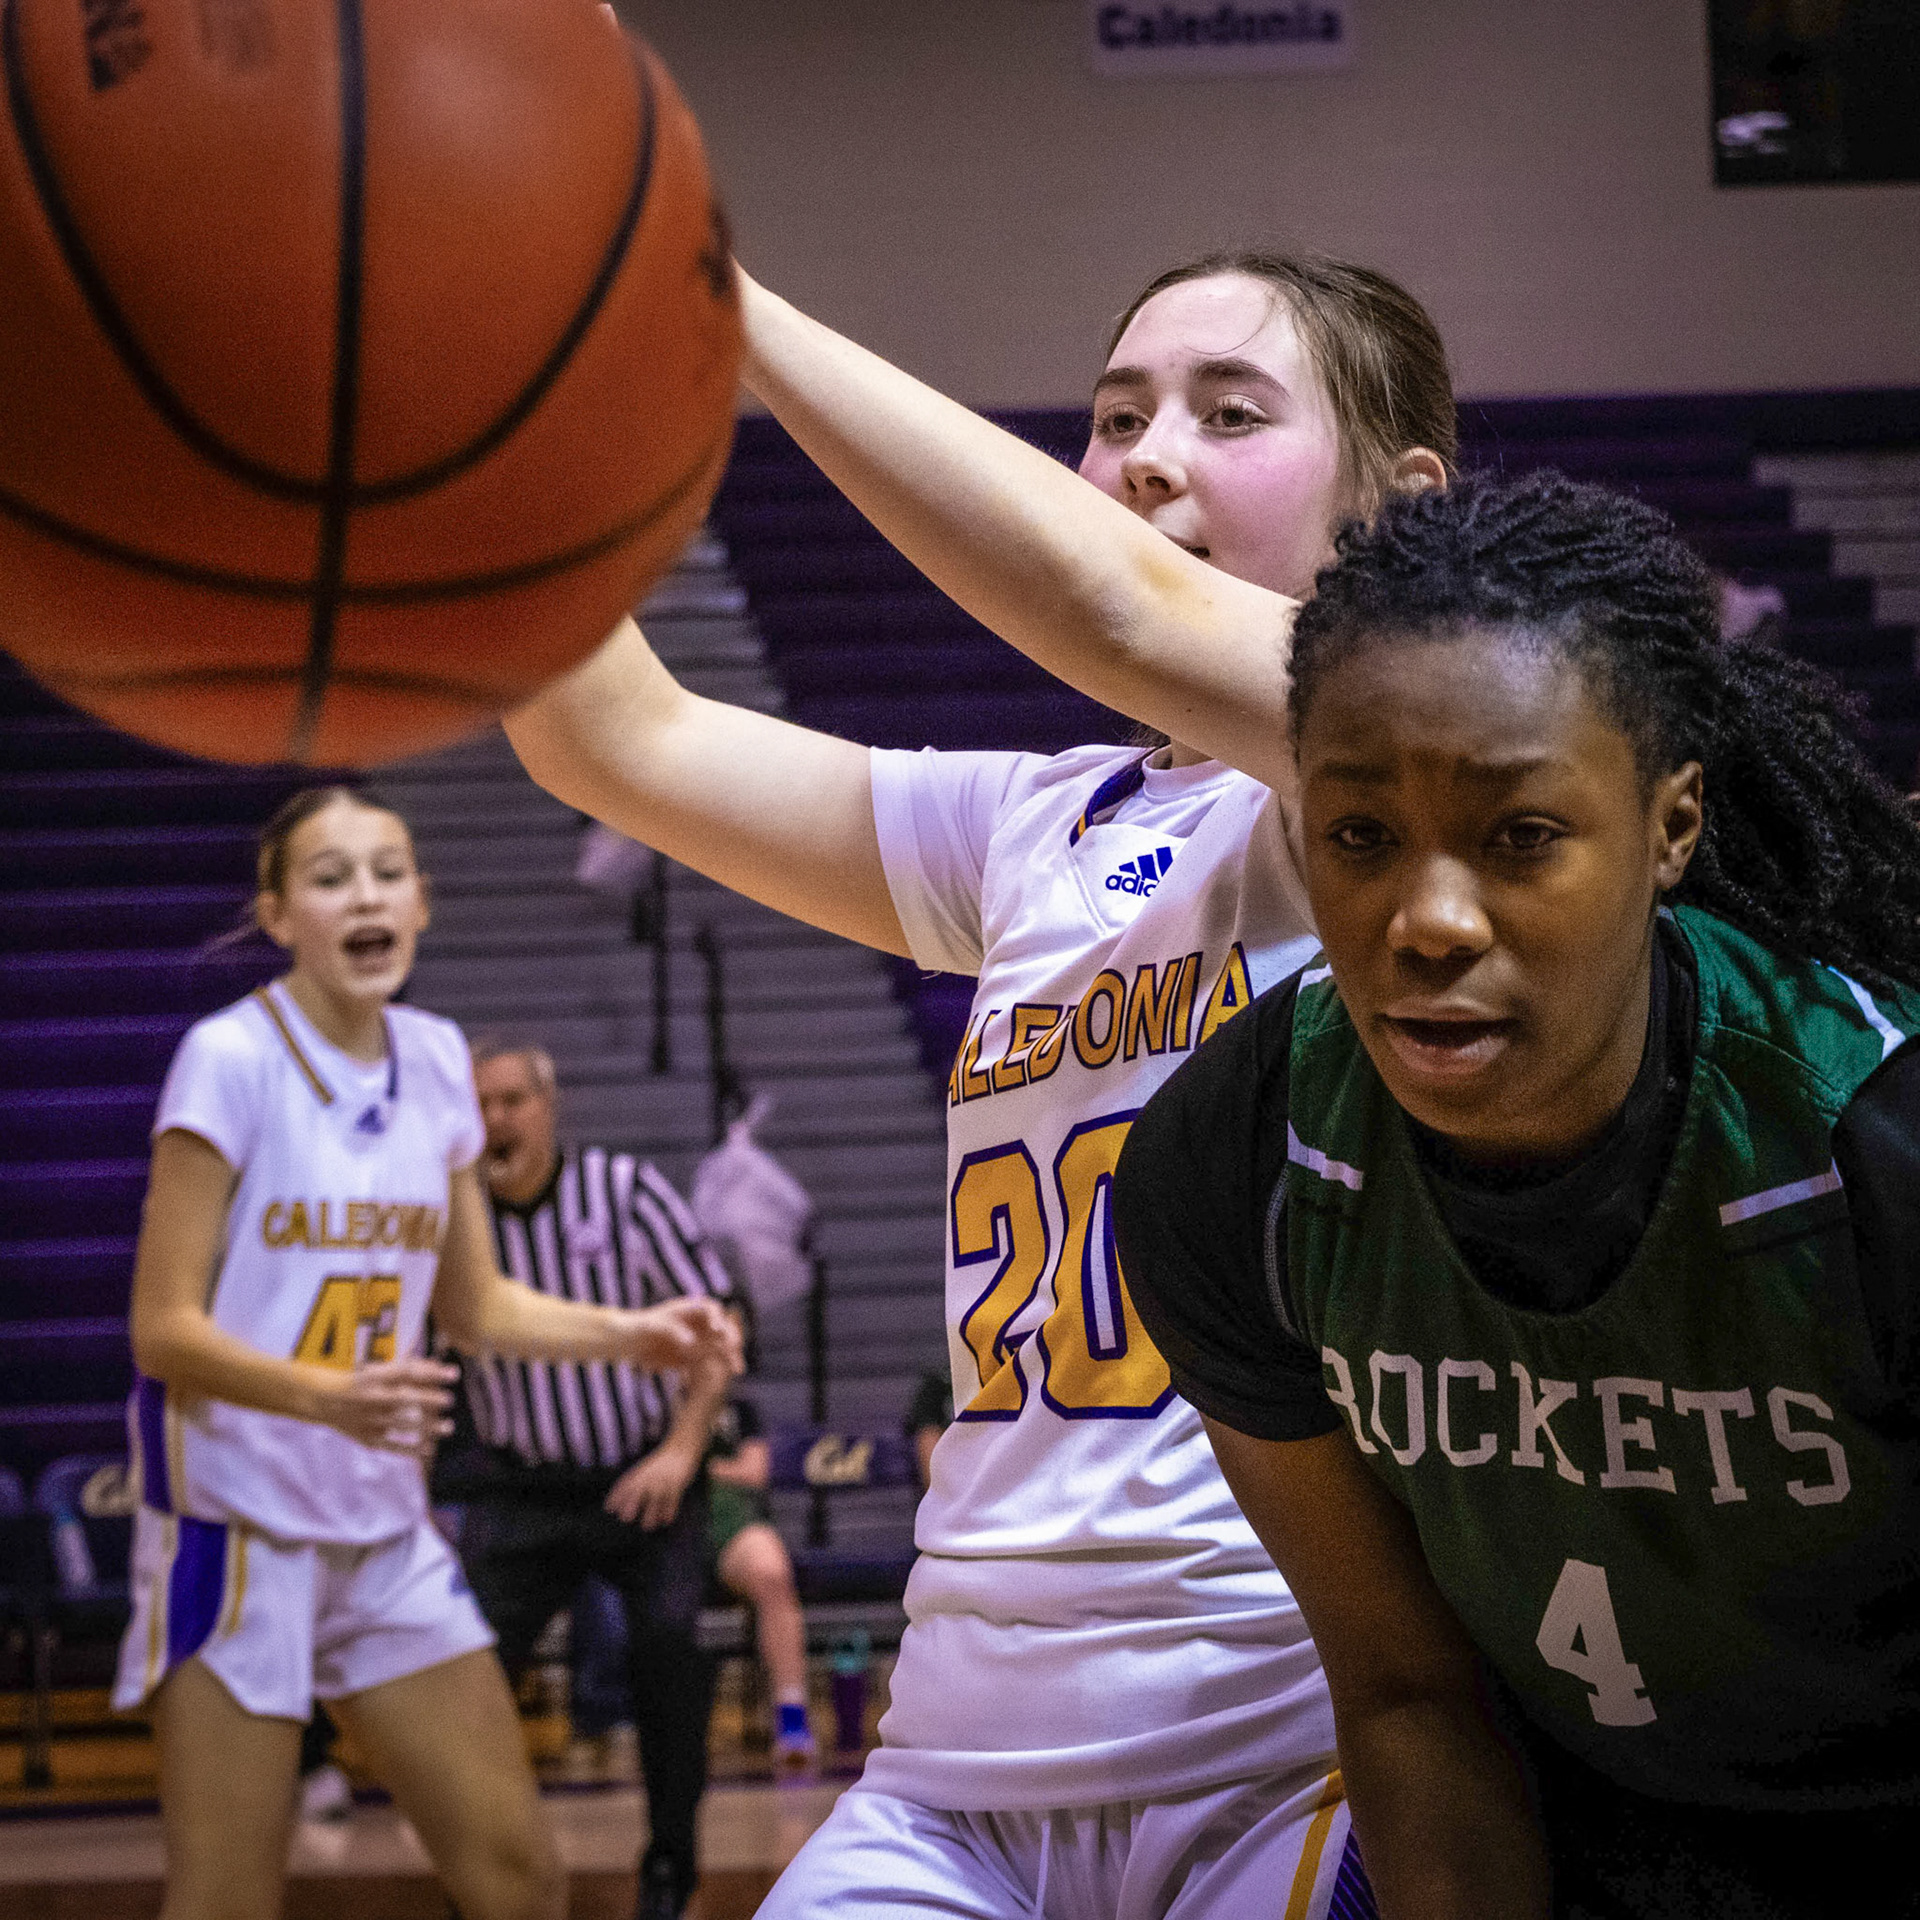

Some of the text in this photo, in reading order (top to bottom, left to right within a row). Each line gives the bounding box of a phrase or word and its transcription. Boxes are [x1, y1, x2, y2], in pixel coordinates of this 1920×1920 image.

[952, 1108, 1178, 1422] 20
[1321, 1346, 1851, 1506] ROCKETS
[1535, 1558, 1657, 1727] 4
